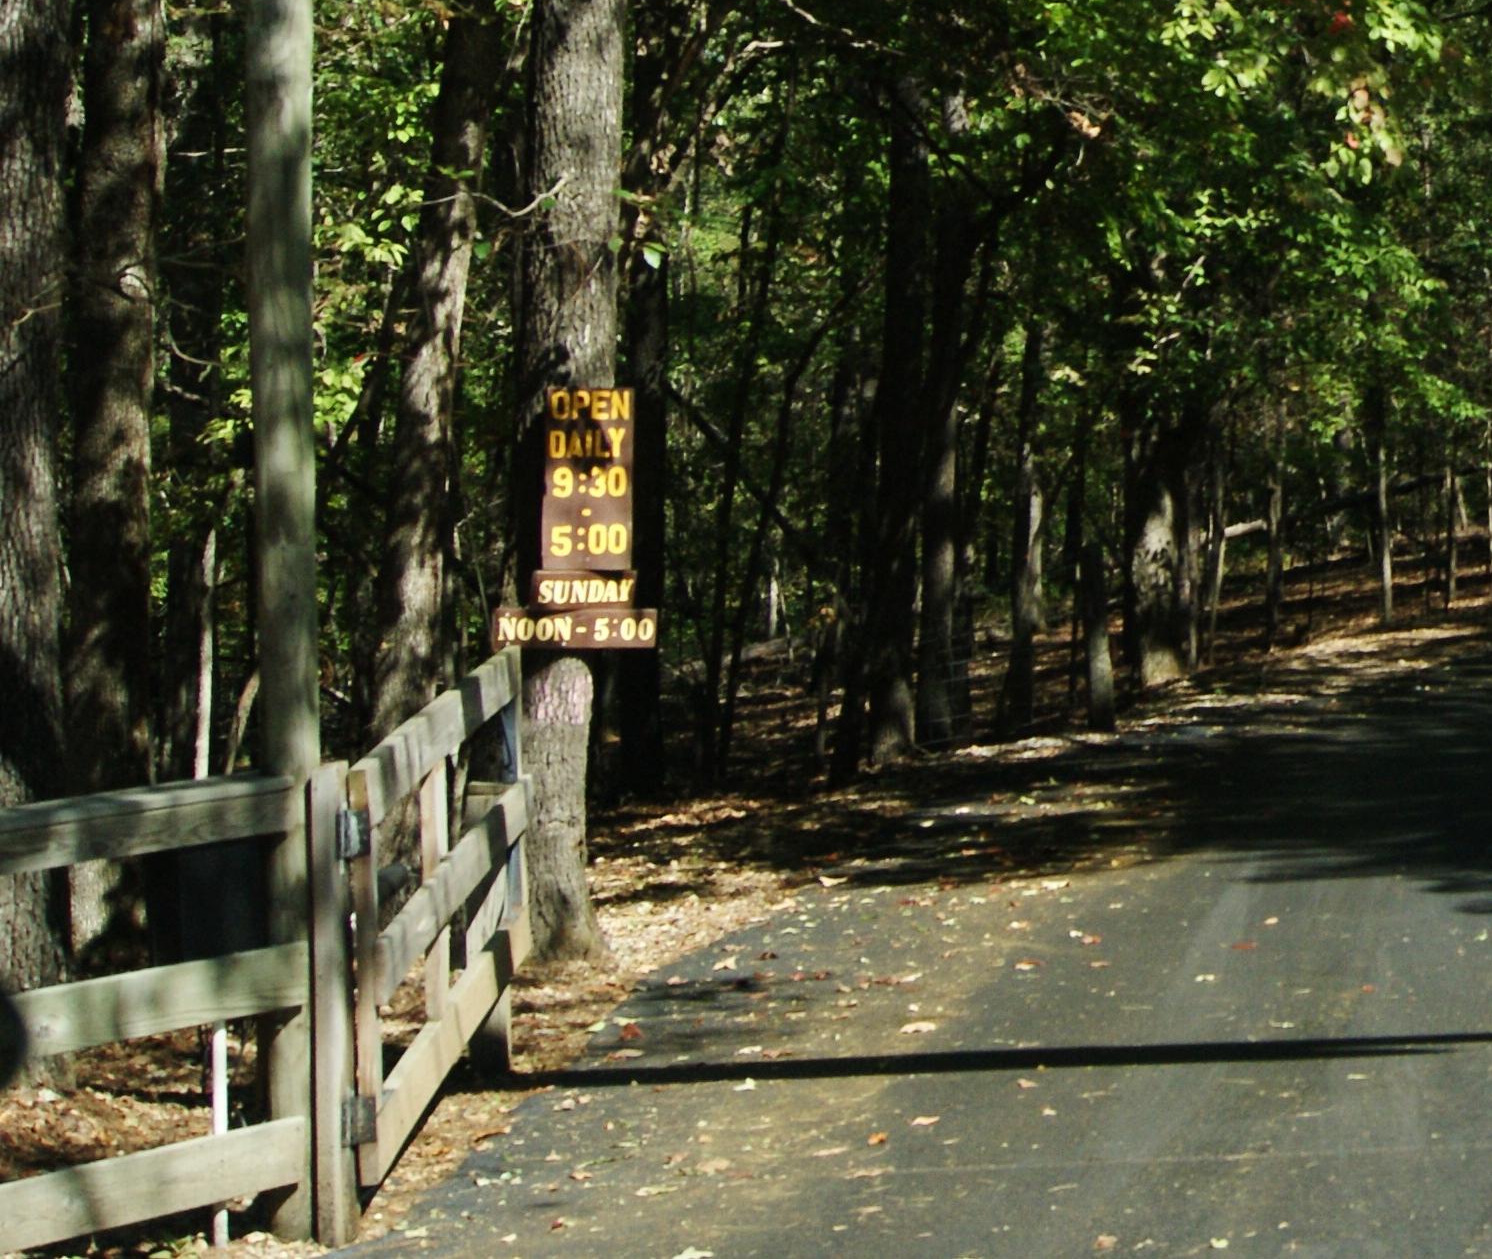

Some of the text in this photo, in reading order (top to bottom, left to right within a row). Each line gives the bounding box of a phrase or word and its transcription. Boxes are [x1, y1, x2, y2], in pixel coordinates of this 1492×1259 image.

[550, 390, 630, 421] OPEN
[549, 427, 626, 460] DAILY
[552, 466, 628, 498] 9:30
[550, 523, 628, 557] 5:00
[537, 578, 634, 605] SUNDAY
[593, 616, 655, 642] 5:00
